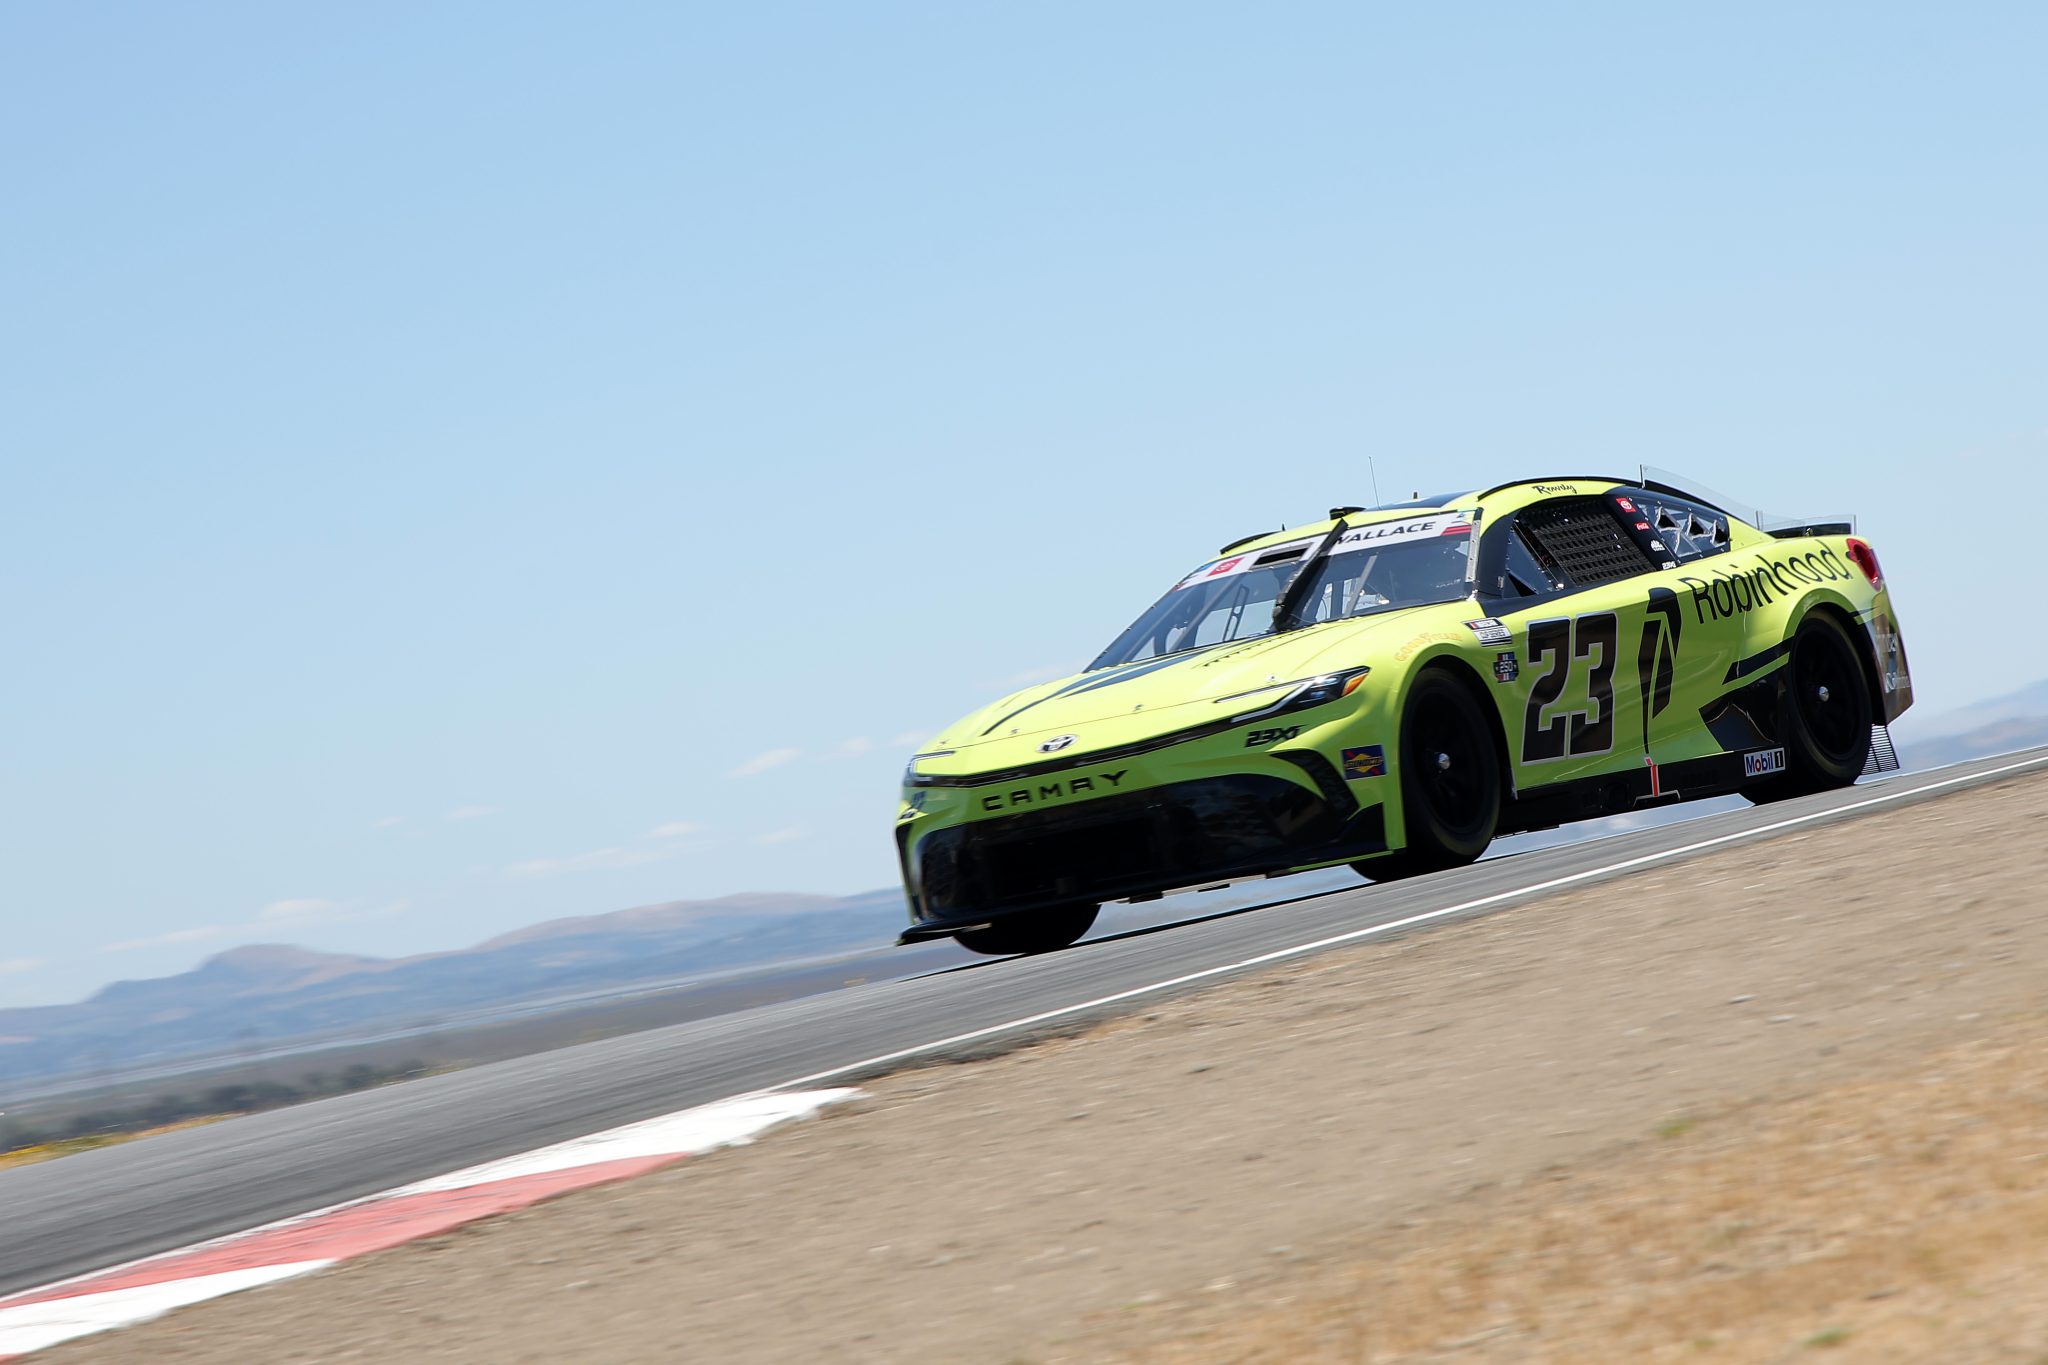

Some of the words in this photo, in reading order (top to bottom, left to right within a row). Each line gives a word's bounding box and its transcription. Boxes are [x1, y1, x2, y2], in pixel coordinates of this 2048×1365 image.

[1677, 539, 1854, 624] Robinhood
[1500, 661, 1513, 673] 250
[1520, 610, 1618, 766] 23
[1745, 751, 1774, 774] Mobil
[982, 769, 1129, 811] CAMRY
